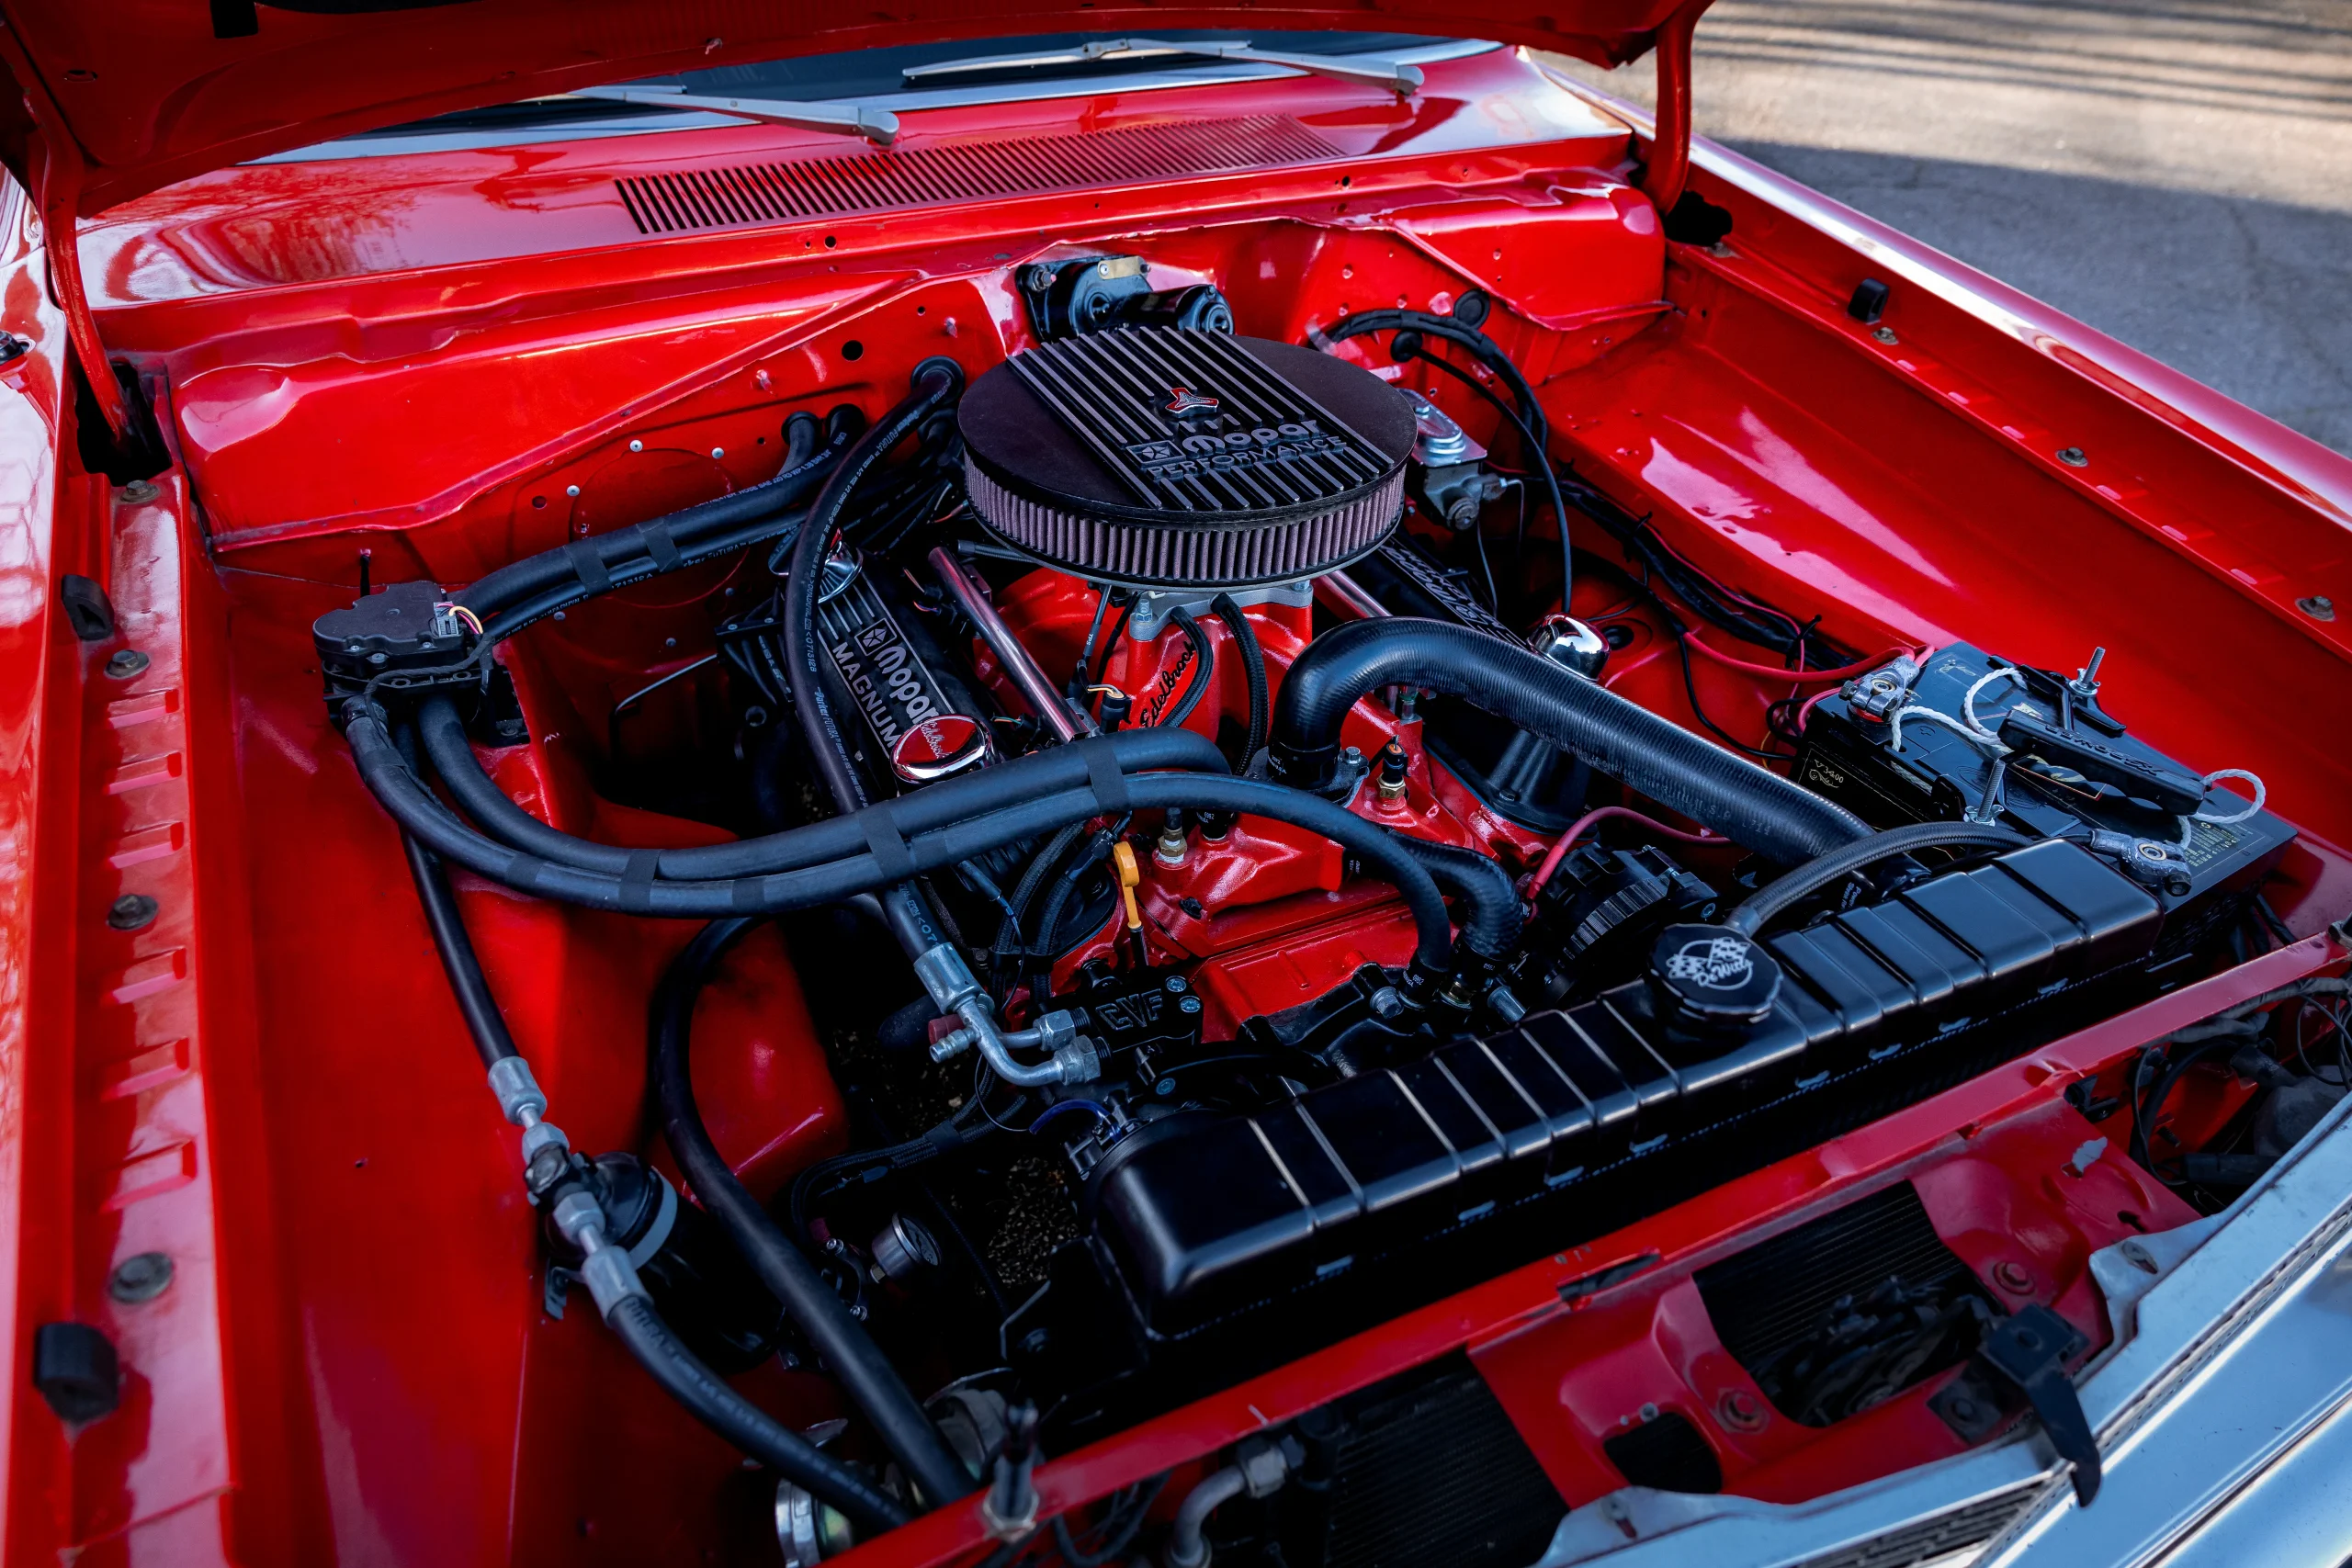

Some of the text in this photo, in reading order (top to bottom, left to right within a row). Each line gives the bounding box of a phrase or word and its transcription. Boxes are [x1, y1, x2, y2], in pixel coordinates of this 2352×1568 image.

[1148, 435, 1349, 481] PERFORMANCE
[1182, 420, 1320, 457] Mopar
[832, 642, 901, 748] MAGNUM
